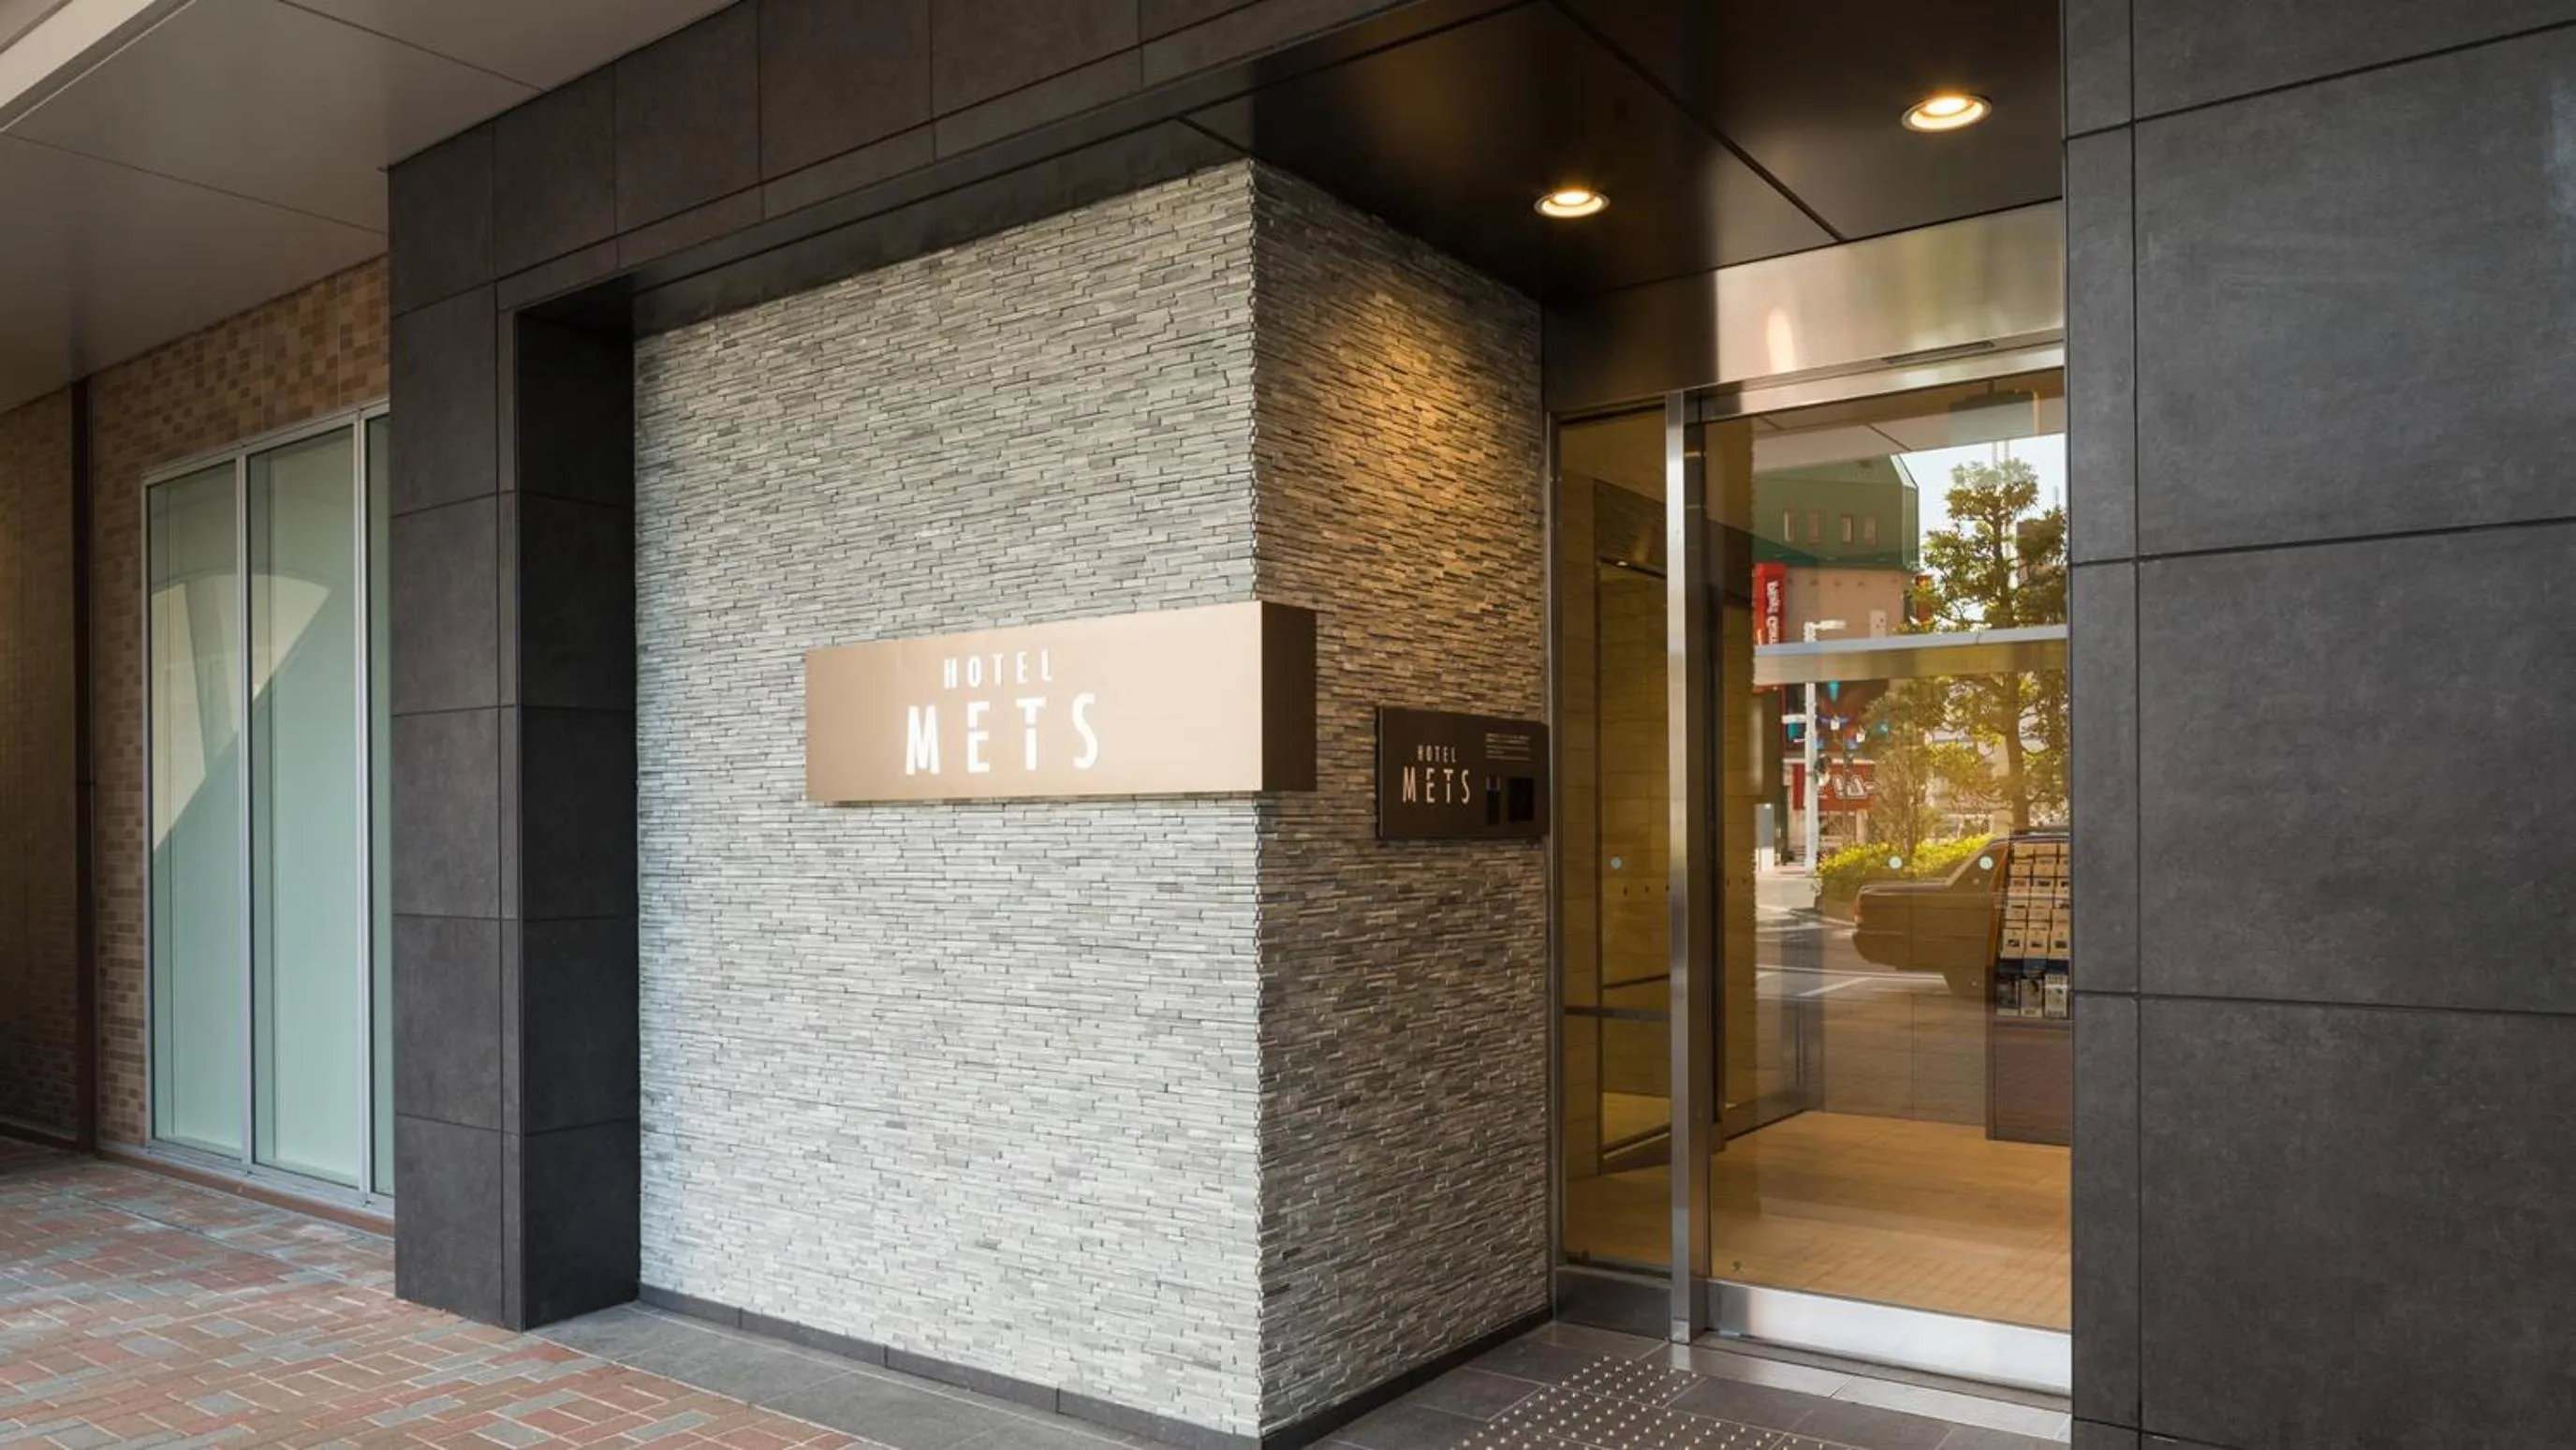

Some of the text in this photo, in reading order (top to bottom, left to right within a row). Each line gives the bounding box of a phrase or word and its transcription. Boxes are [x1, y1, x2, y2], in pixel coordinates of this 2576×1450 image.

[943, 648, 1053, 689] HOTEL
[905, 692, 1099, 776] METS
[1416, 745, 1457, 764] HOTEL
[1402, 765, 1471, 806] METS
